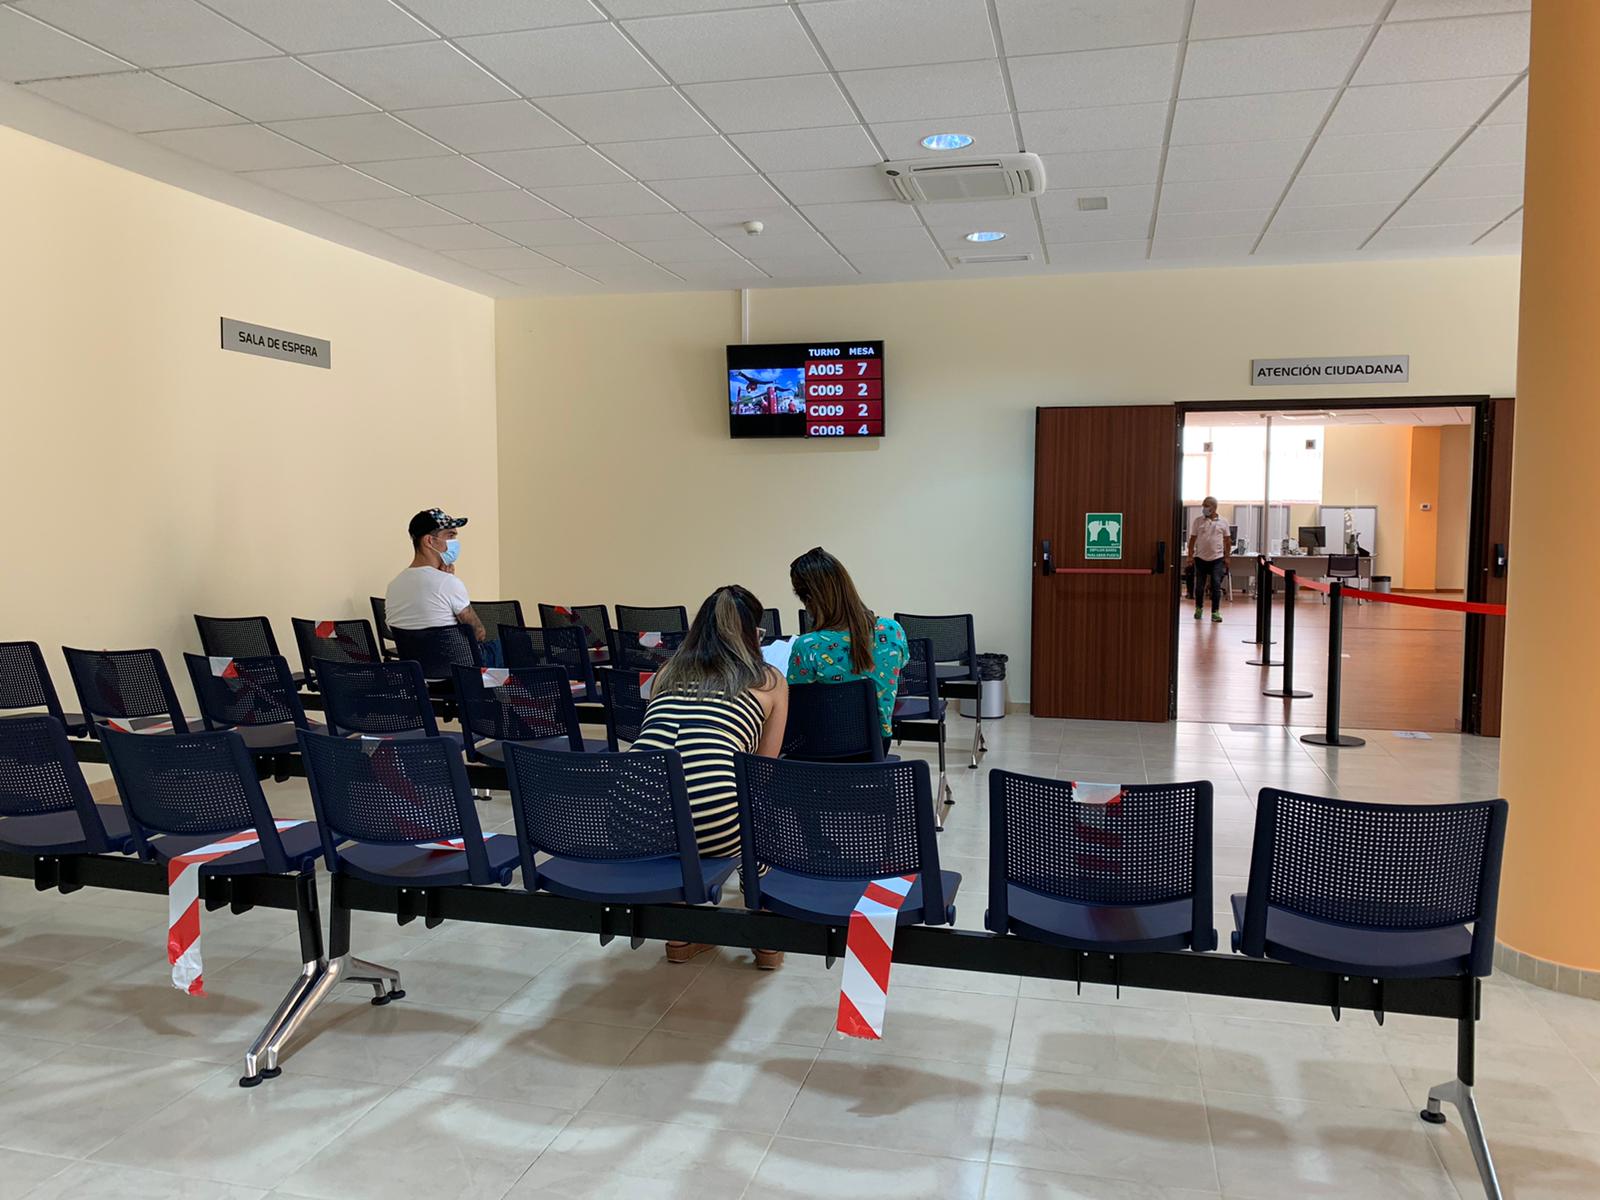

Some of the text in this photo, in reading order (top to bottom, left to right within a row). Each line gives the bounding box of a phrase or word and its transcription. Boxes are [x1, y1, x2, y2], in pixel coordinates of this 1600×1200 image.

[238, 331, 318, 357] SALA DE ESPERA
[808, 347, 874, 357] TURNO MESA
[808, 362, 867, 376] A005 7
[1257, 364, 1404, 377] ATENCIÓN CIUDADANA
[809, 383, 868, 396] C009 2
[809, 404, 868, 416] C009 2
[810, 424, 869, 436] C008 4
